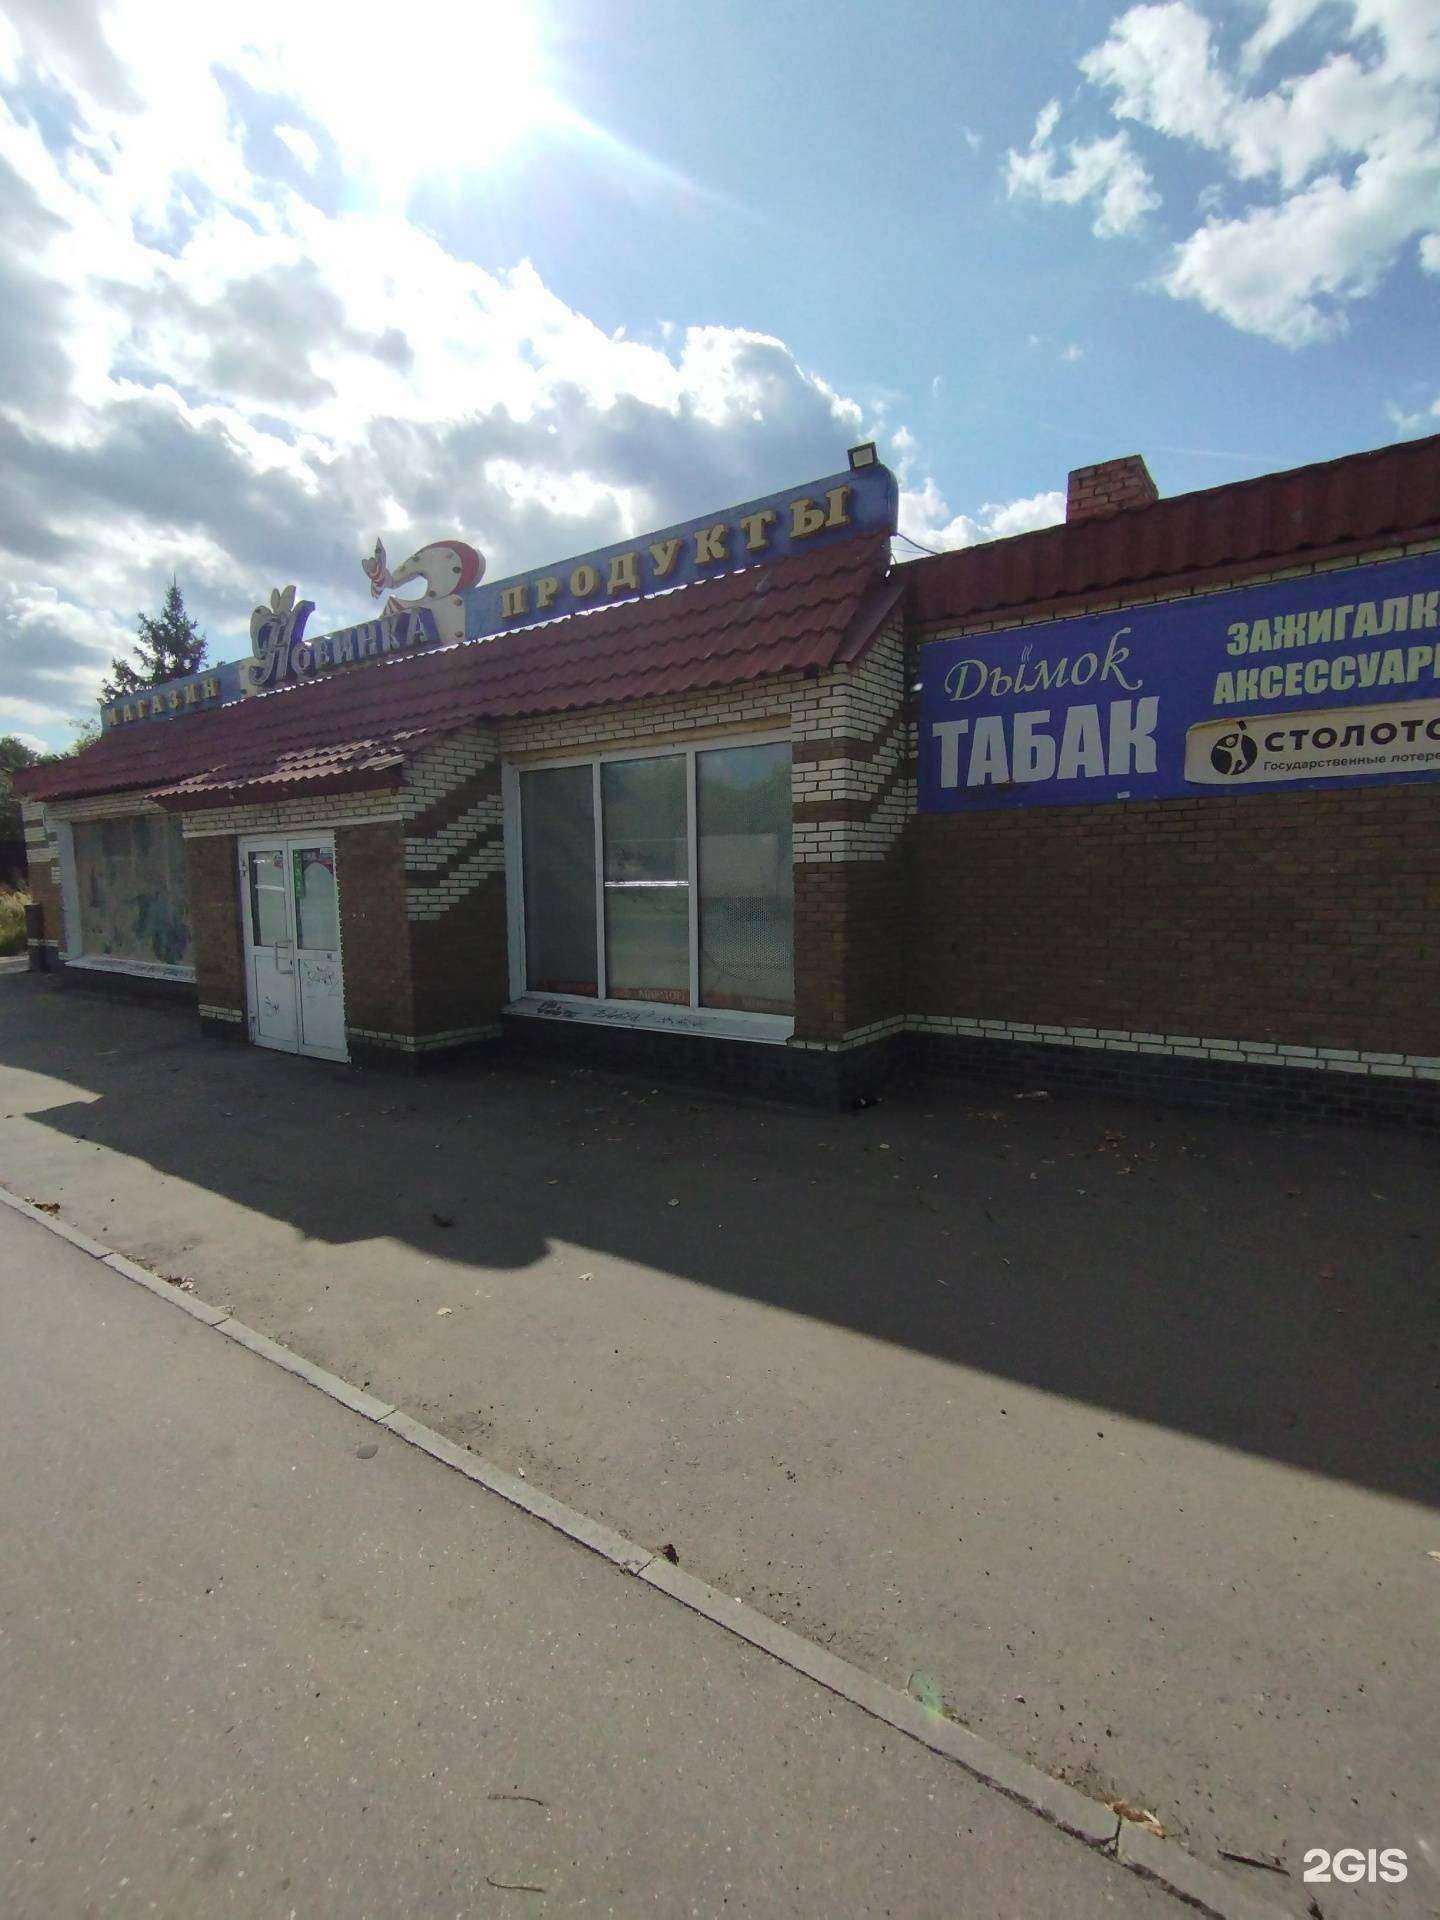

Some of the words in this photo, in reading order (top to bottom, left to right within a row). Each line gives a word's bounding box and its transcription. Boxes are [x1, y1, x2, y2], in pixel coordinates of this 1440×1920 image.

[500, 485, 853, 619] ПРОДУКТЫ
[944, 626, 1144, 702] Дымок
[932, 695, 1160, 789] ТАБАК
[1263, 753, 1387, 771] Государственные
